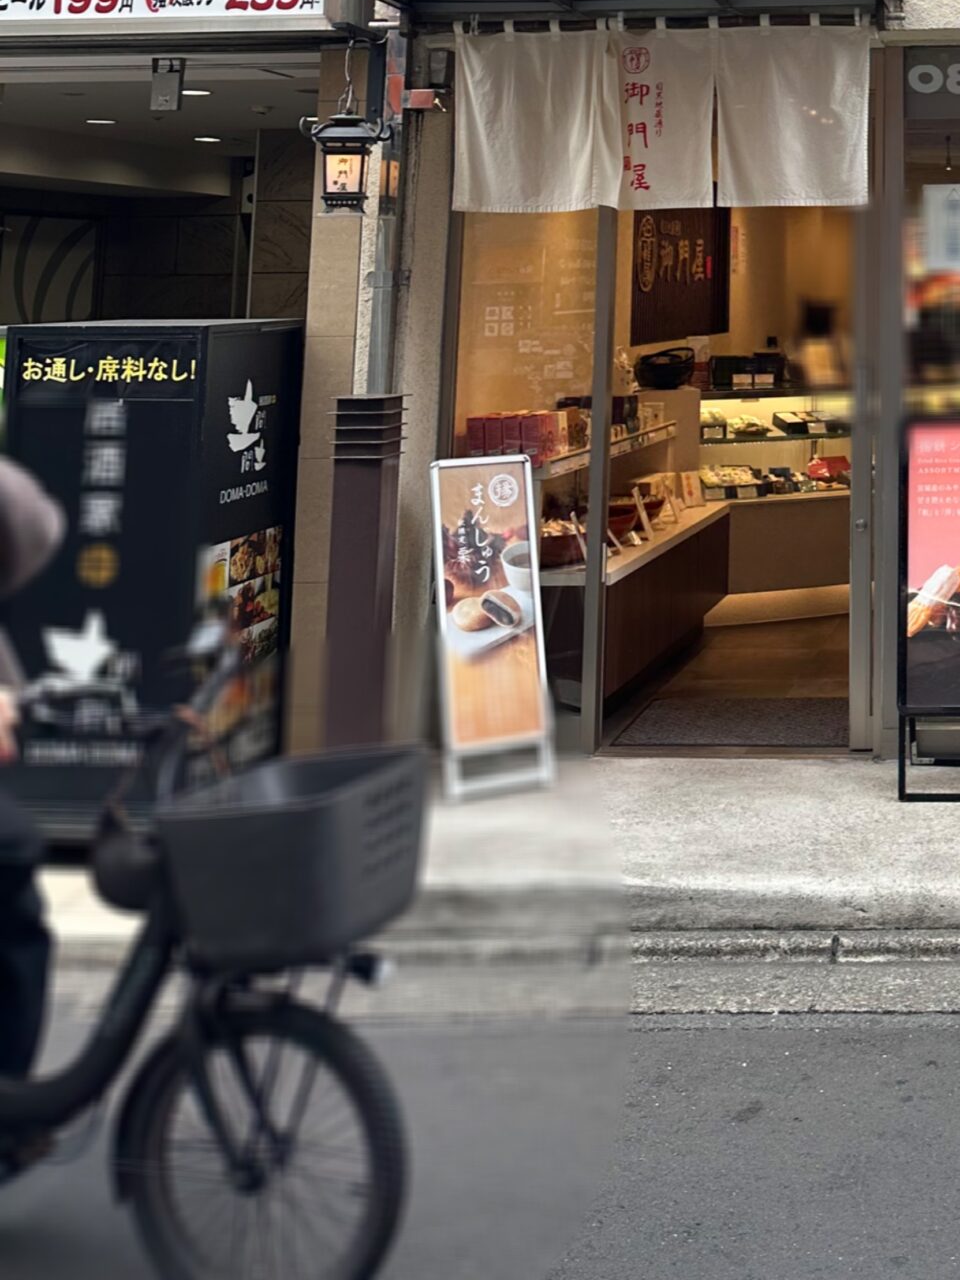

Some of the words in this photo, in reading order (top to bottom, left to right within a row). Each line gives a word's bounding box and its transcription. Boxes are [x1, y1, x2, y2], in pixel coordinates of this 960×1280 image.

[624, 81, 650, 191] 御門屋
[471, 483, 493, 582] まんじゅう
